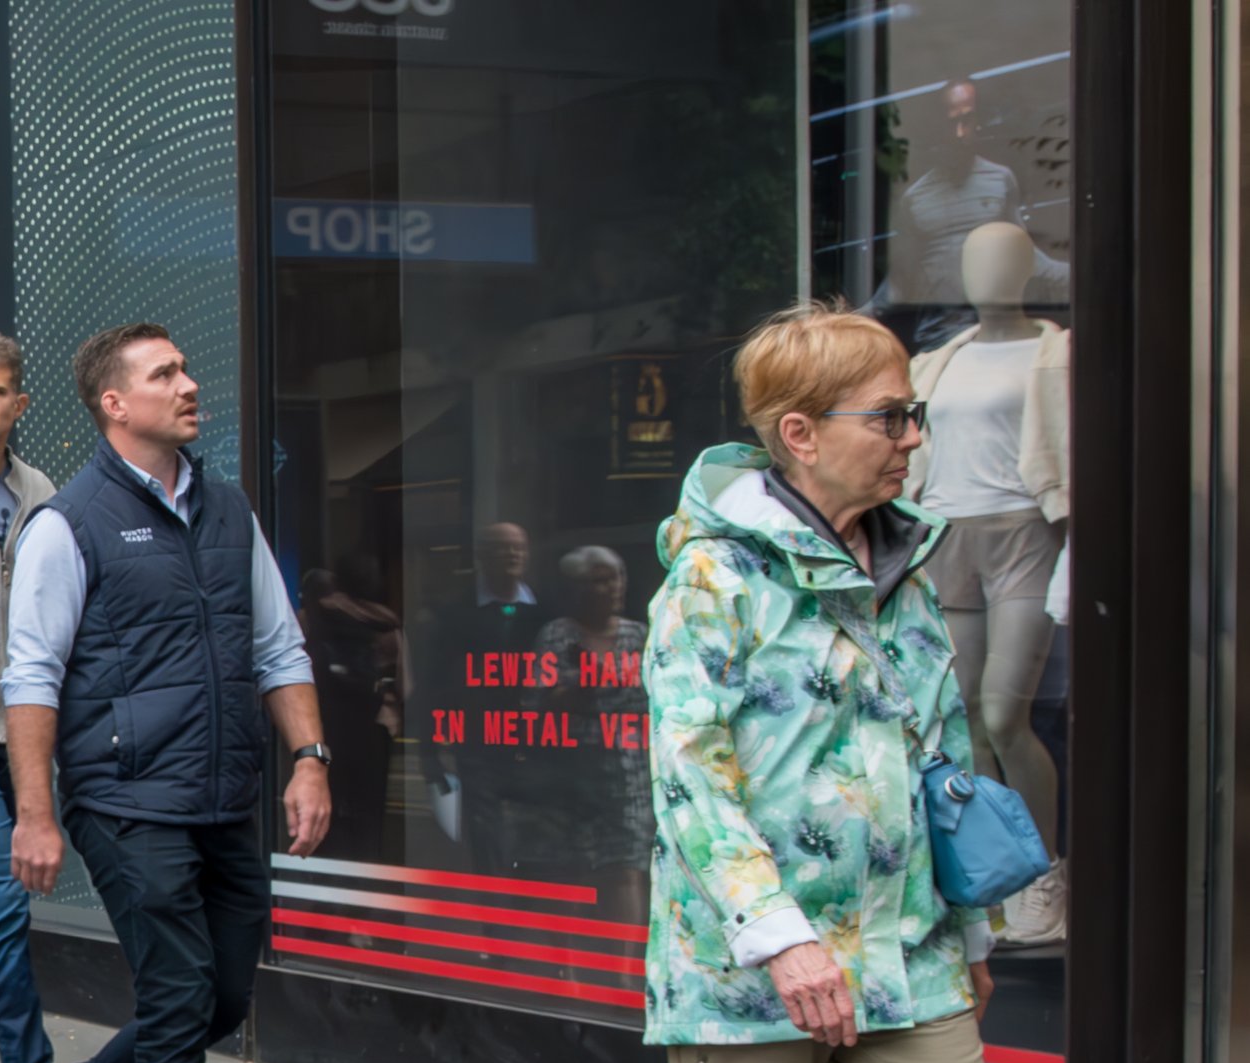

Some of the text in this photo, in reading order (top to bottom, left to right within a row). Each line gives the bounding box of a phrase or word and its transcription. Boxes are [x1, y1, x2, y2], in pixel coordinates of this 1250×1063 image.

[466, 652, 641, 688] LEWIS HAM
[432, 709, 465, 744] IN
[484, 710, 578, 748] METAL
